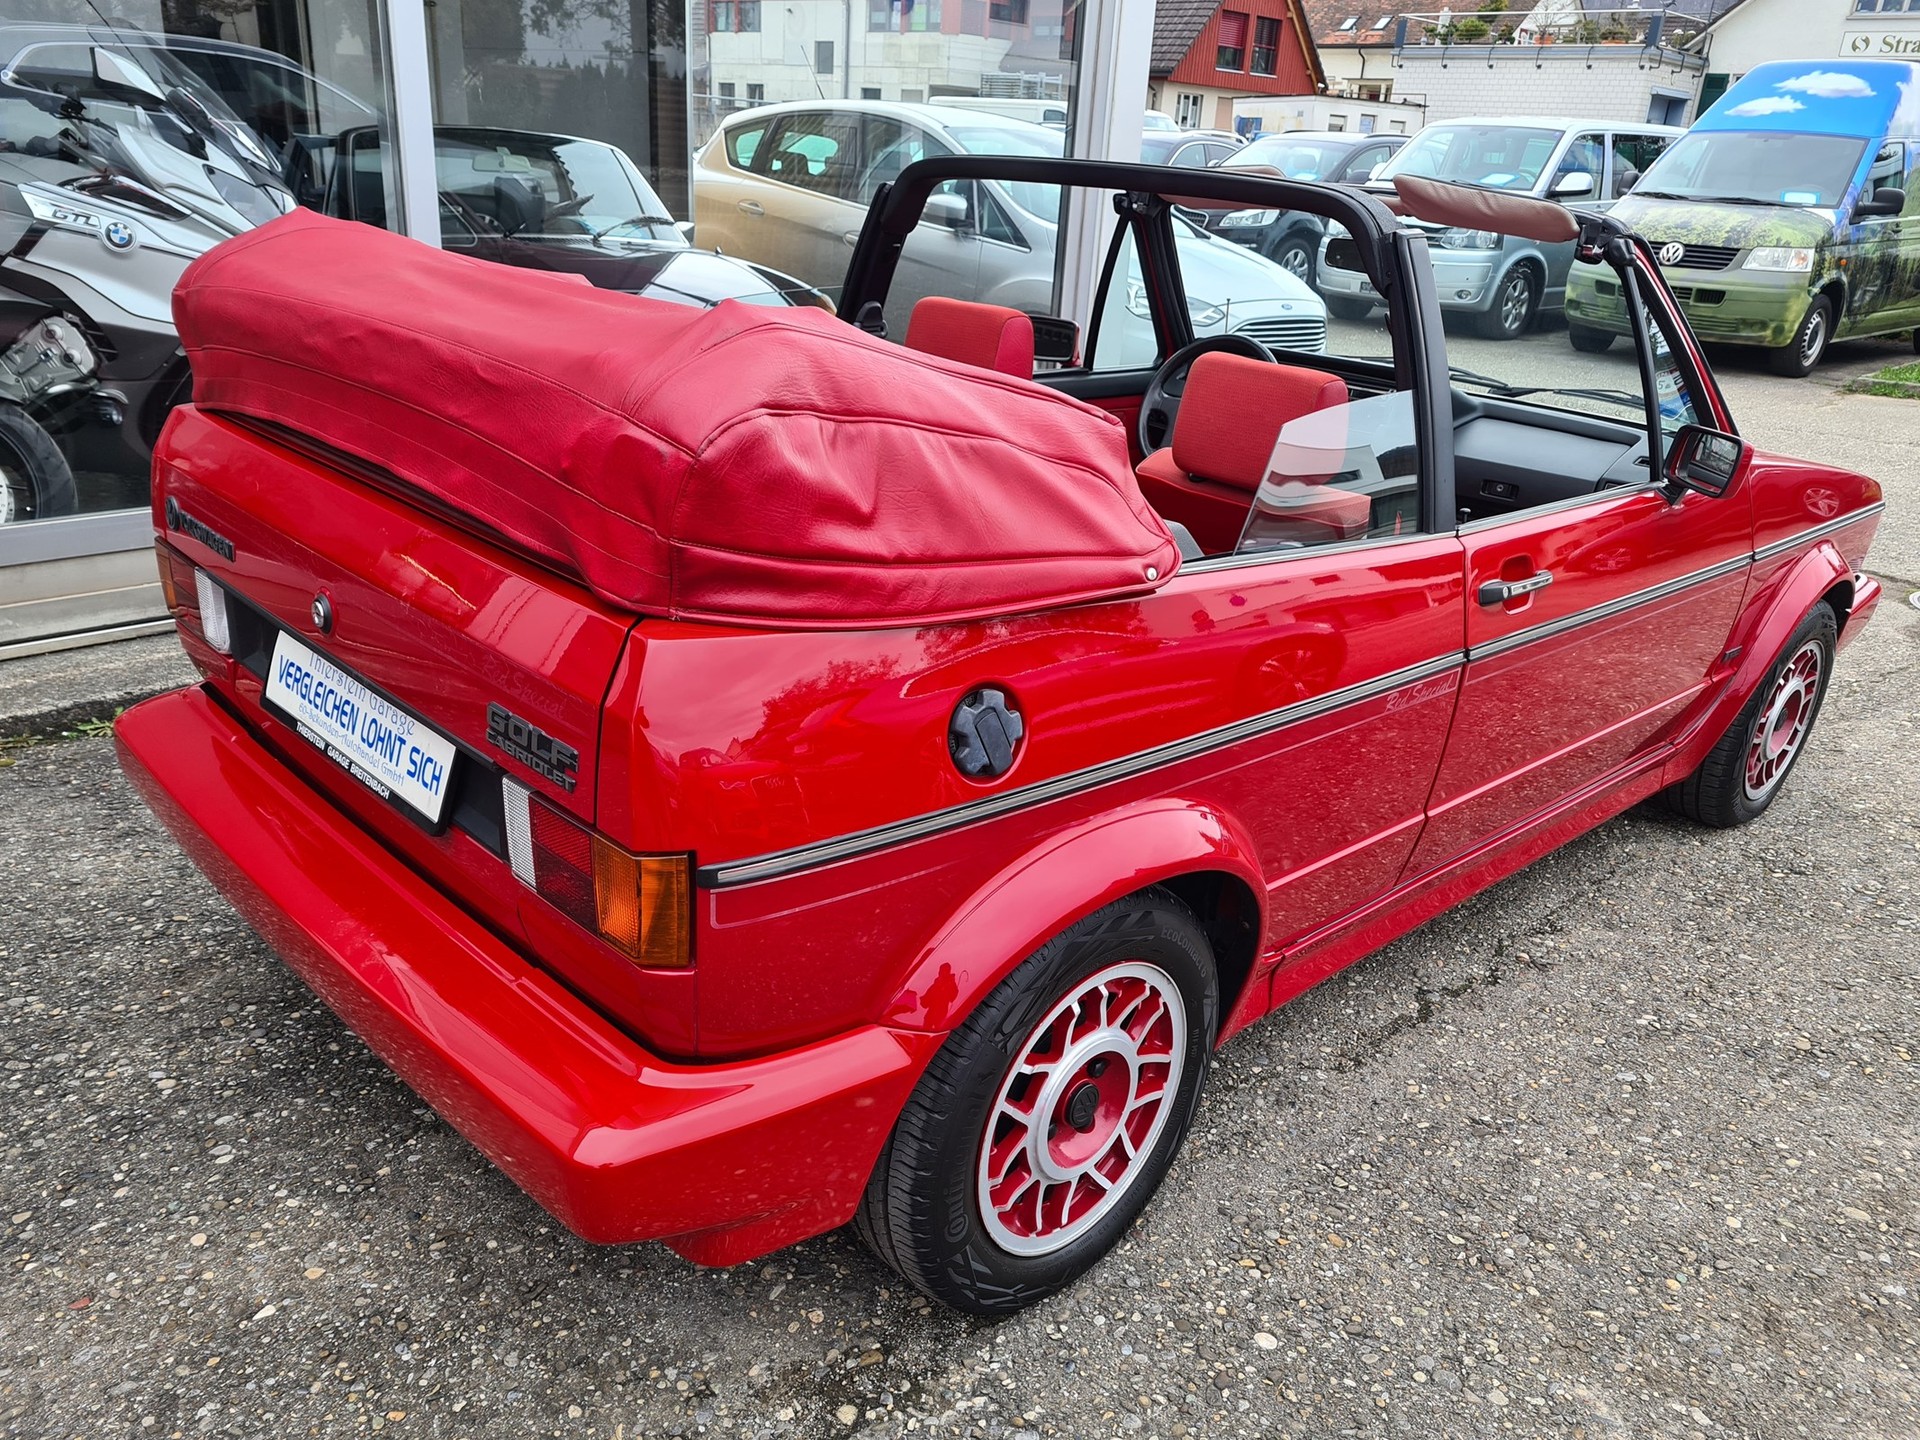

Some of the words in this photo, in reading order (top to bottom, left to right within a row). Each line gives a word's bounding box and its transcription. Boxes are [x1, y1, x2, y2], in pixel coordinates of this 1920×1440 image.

[1879, 35, 1920, 53] Stra
[51, 208, 99, 227] GTL
[369, 688, 416, 736] Garage
[1384, 688, 1412, 713] Red
[1412, 673, 1454, 700] Special
[278, 654, 360, 736] VERGLEICHEN
[360, 712, 407, 767] LOHNT
[406, 745, 444, 796] SICH
[486, 701, 579, 774] GOLF
[296, 721, 325, 751] THIERSTEIN
[326, 746, 350, 770] GARAGE
[349, 763, 391, 800] BREITENBACH
[486, 727, 577, 794] CABRIOLET
